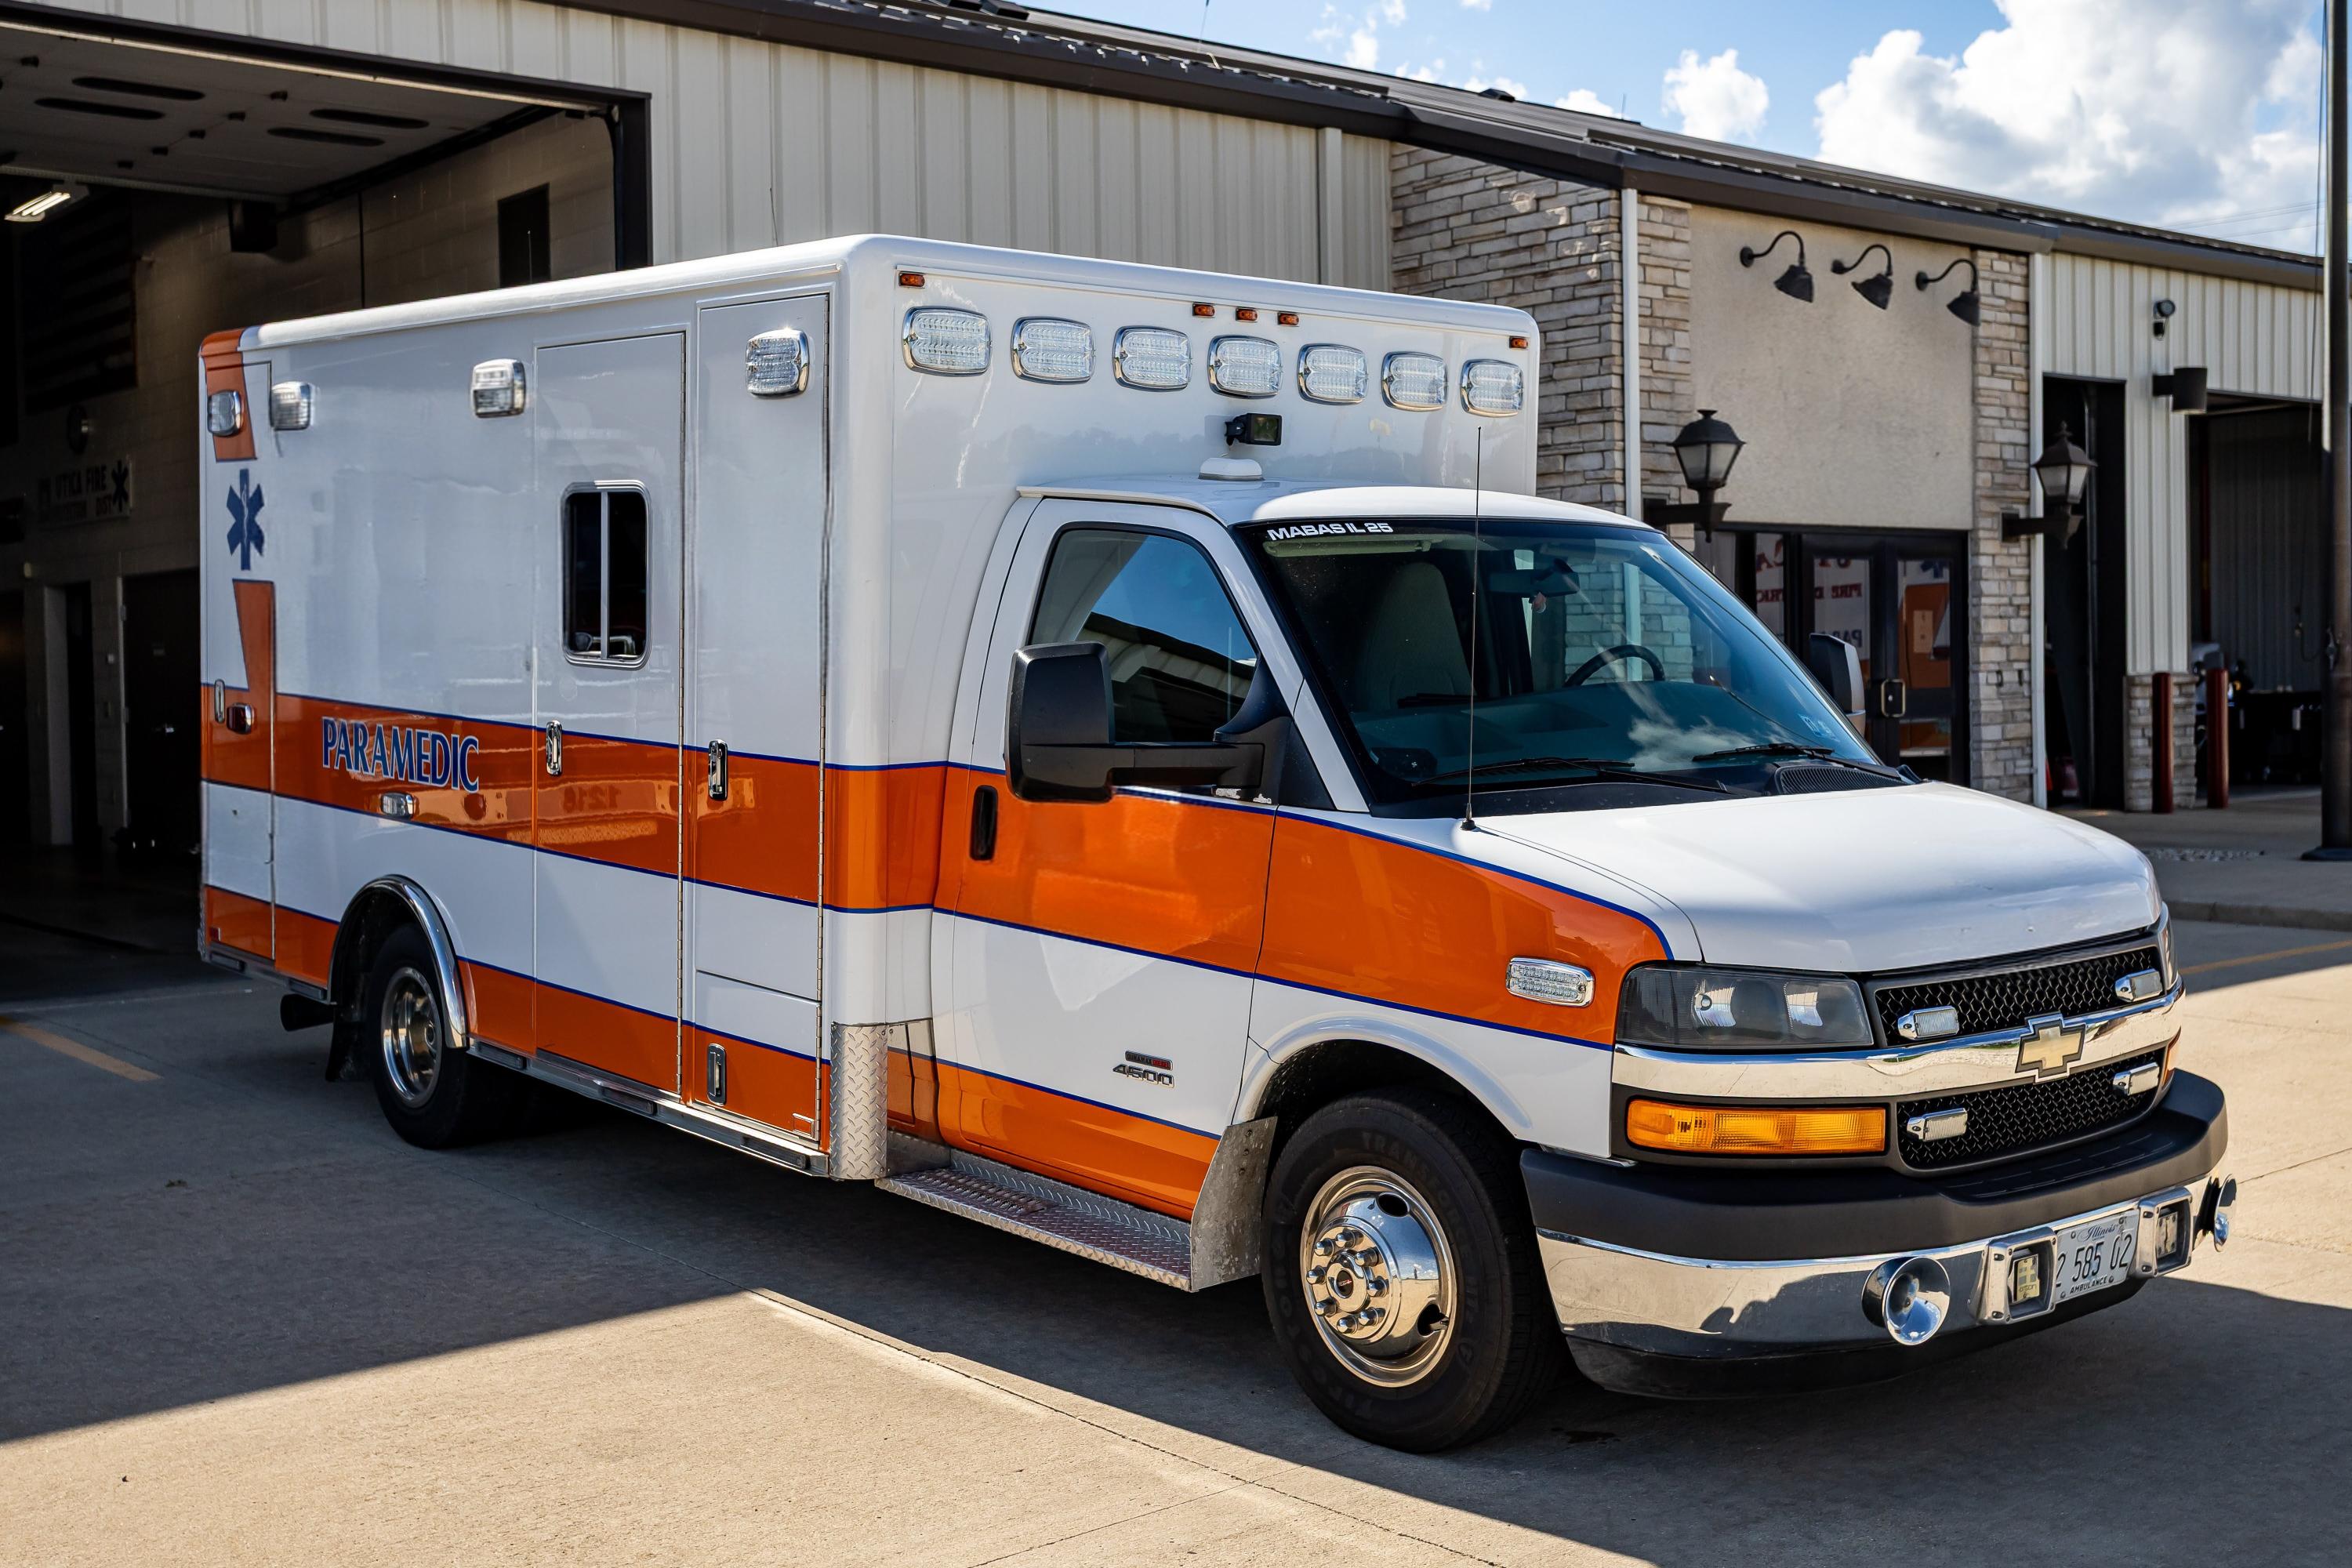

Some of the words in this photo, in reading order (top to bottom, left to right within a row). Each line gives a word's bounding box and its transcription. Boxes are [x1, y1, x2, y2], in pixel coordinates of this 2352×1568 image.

[86, 465, 107, 492] FIRE
[1267, 524, 1346, 541] MABAS
[1345, 523, 1366, 533] IL
[1363, 522, 1394, 533] 25
[322, 716, 479, 793] PARAMEDIC
[1112, 1064, 1174, 1088] 4500
[2077, 1223, 2116, 1242] Illinois
[2072, 1241, 2104, 1282] 585
[2070, 1276, 2107, 1294] AMBULANCE
